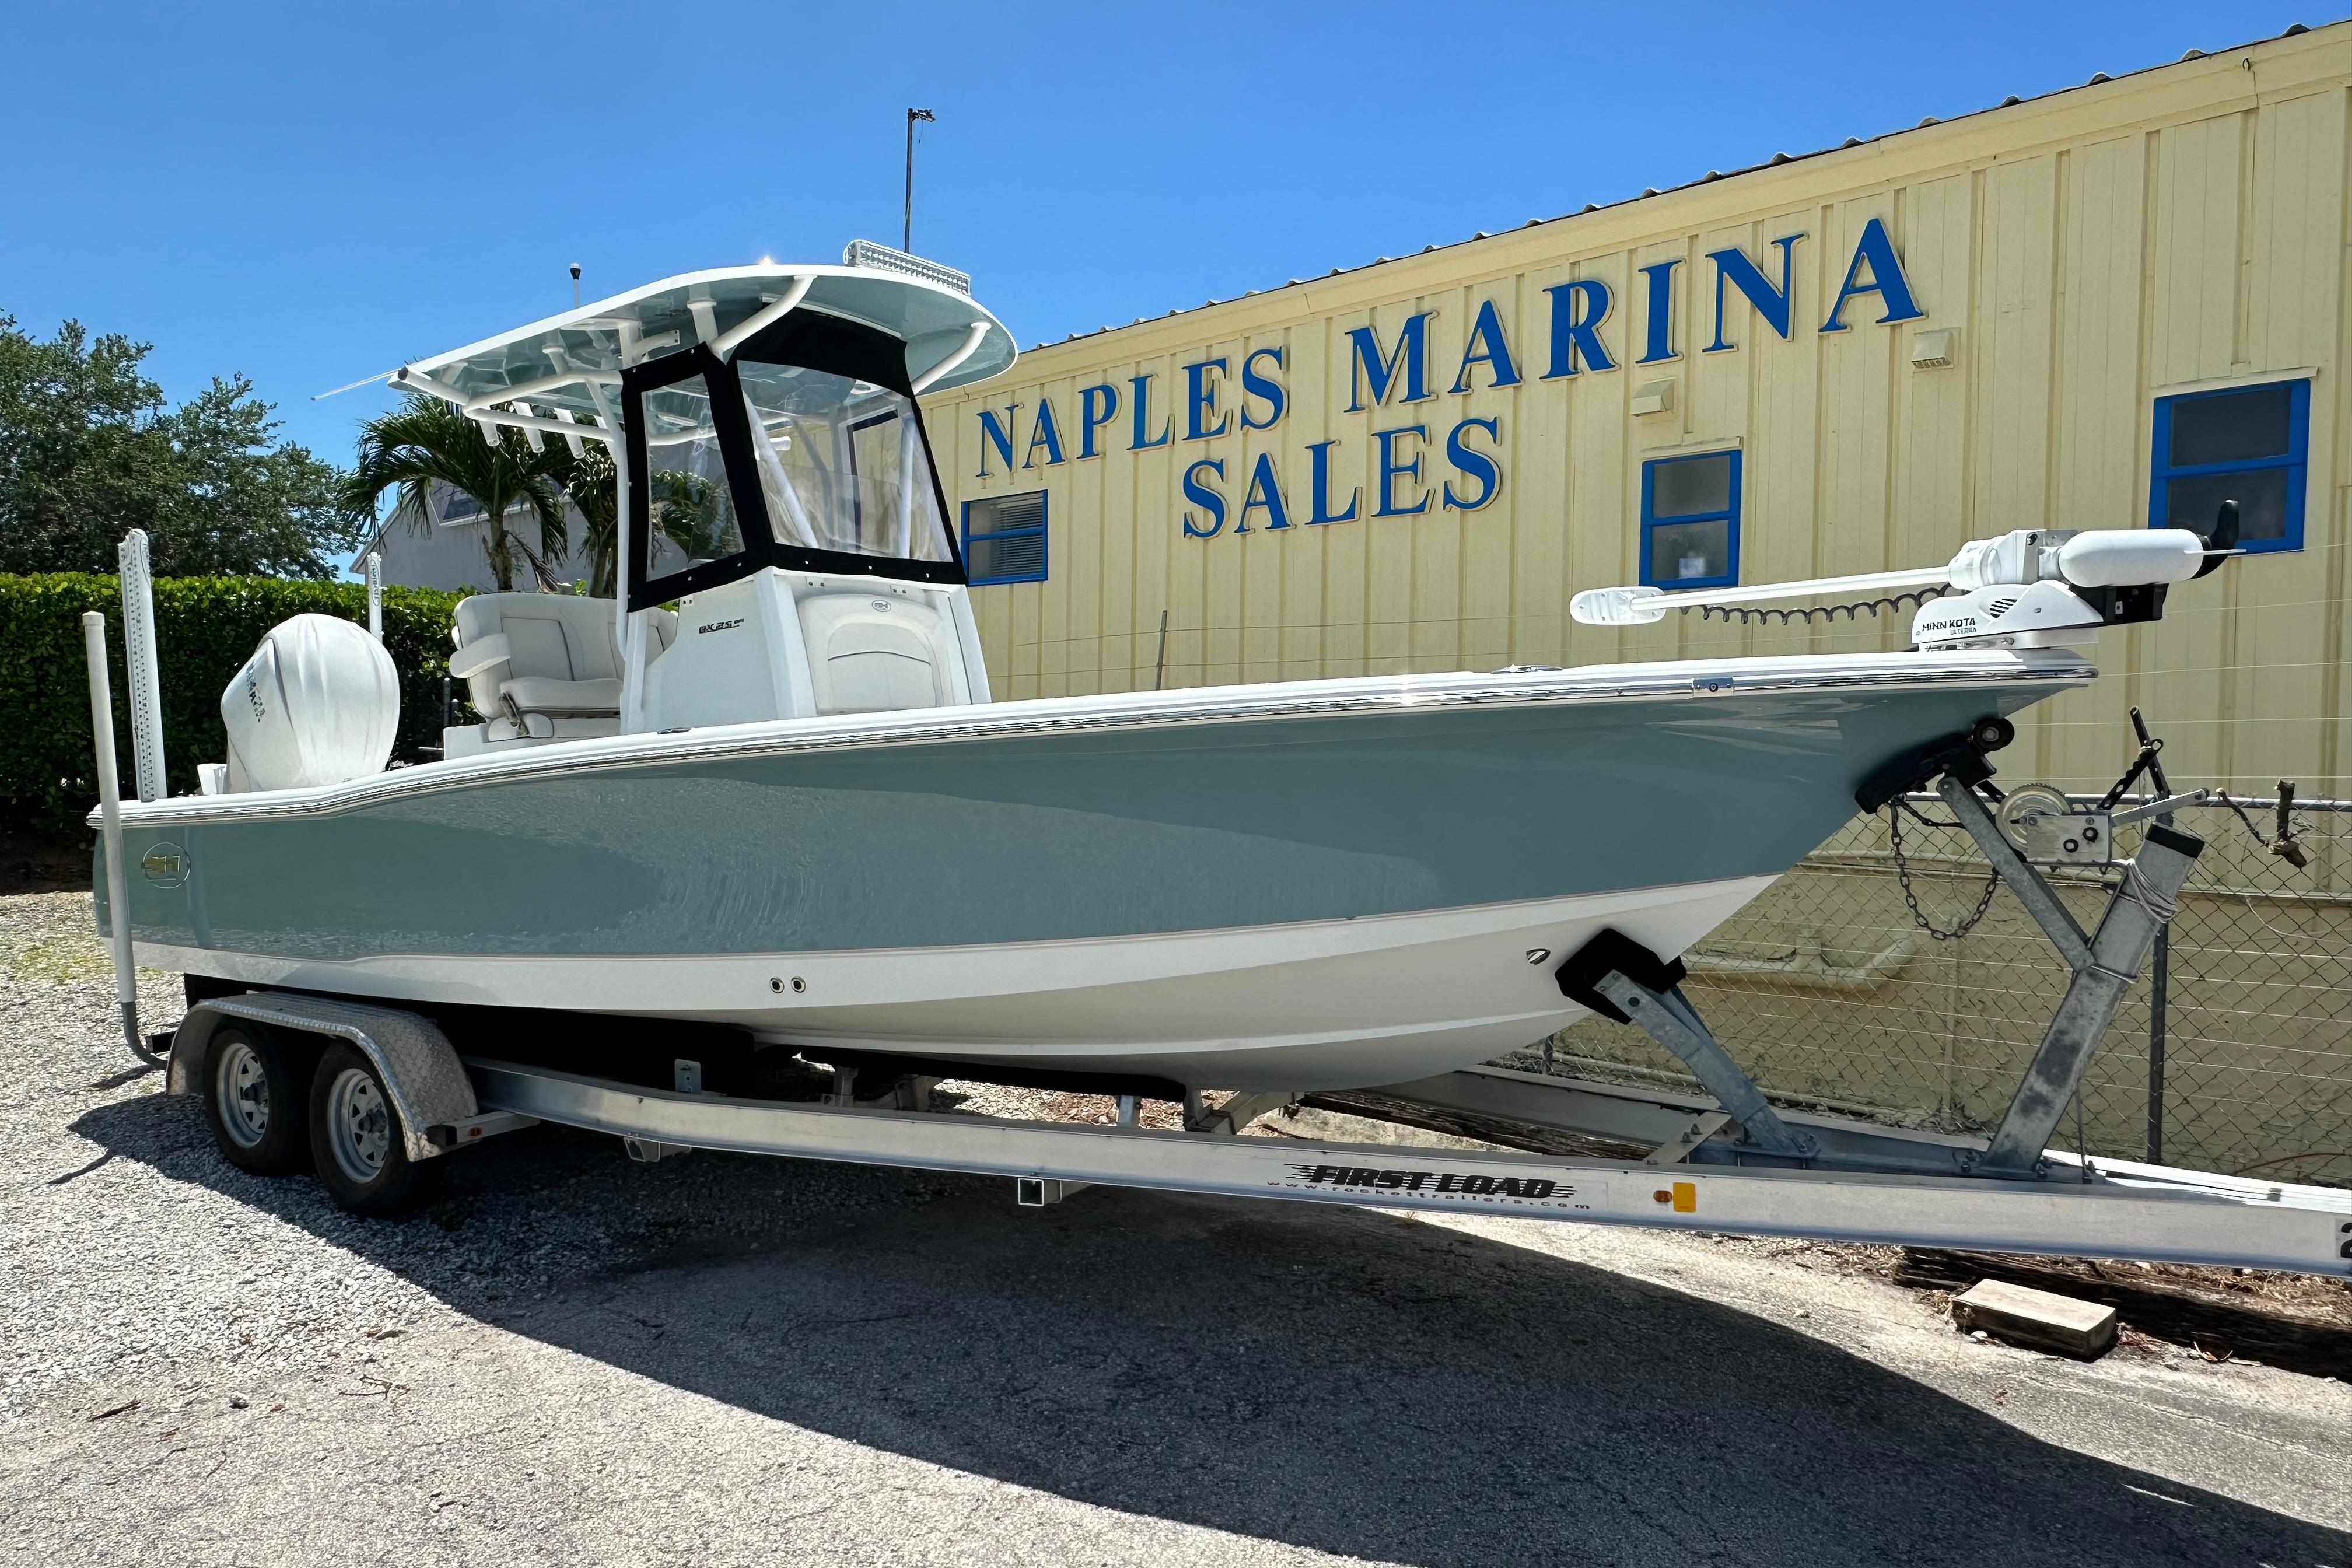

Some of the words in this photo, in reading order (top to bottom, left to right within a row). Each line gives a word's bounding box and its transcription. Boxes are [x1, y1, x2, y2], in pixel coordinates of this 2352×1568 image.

[975, 345, 1288, 478] NAPLES
[1344, 218, 1927, 414] MARINA
[1182, 416, 1502, 540] SALES
[1922, 620, 1947, 632] MINN
[1949, 617, 1976, 628] KOTA
[1308, 1165, 1433, 1191] FIRST
[1434, 1173, 1557, 1199] LOAD
